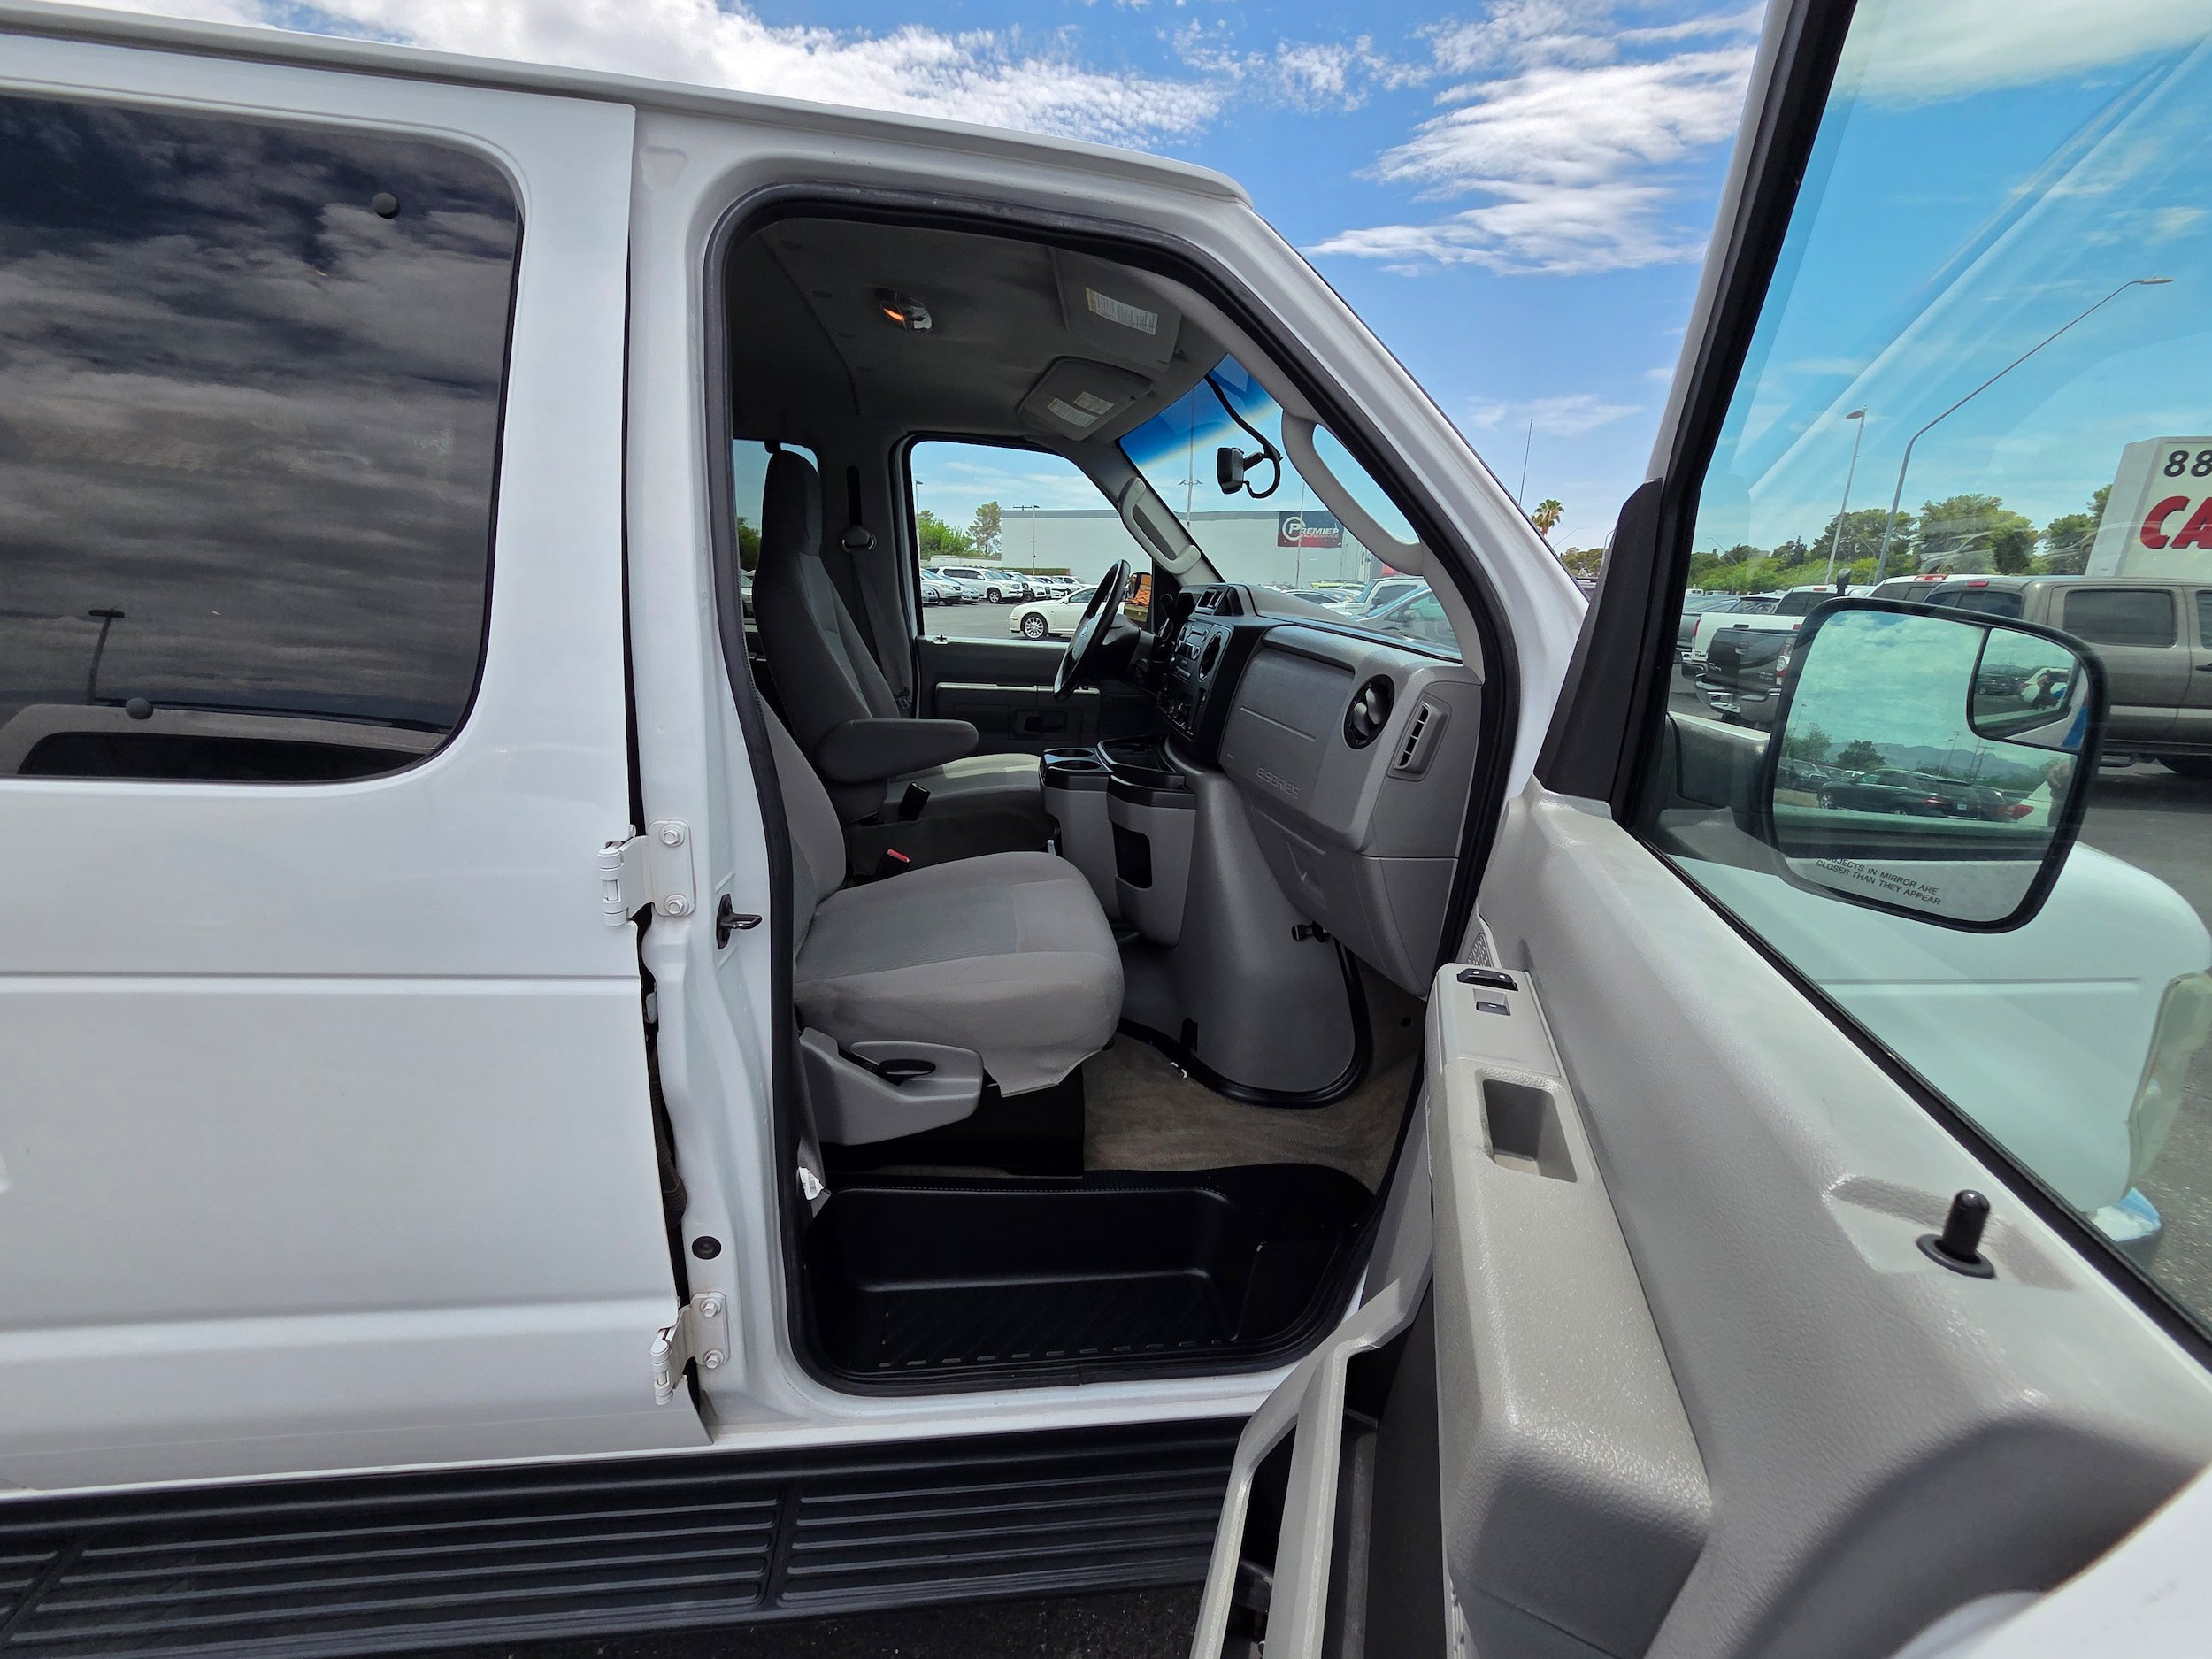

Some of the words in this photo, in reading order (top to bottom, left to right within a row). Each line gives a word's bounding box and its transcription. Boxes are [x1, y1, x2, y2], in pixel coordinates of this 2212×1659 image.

[2163, 449, 2212, 477] 88
[2139, 495, 2212, 549] CA
[1816, 859, 1850, 875] CLOSER
[1852, 872, 1876, 884] THAN
[1878, 879, 1902, 893] THEY
[1903, 888, 1941, 905] APPEAR
[1879, 871, 1916, 888] MIRROR
[1918, 884, 1939, 895] ARE
